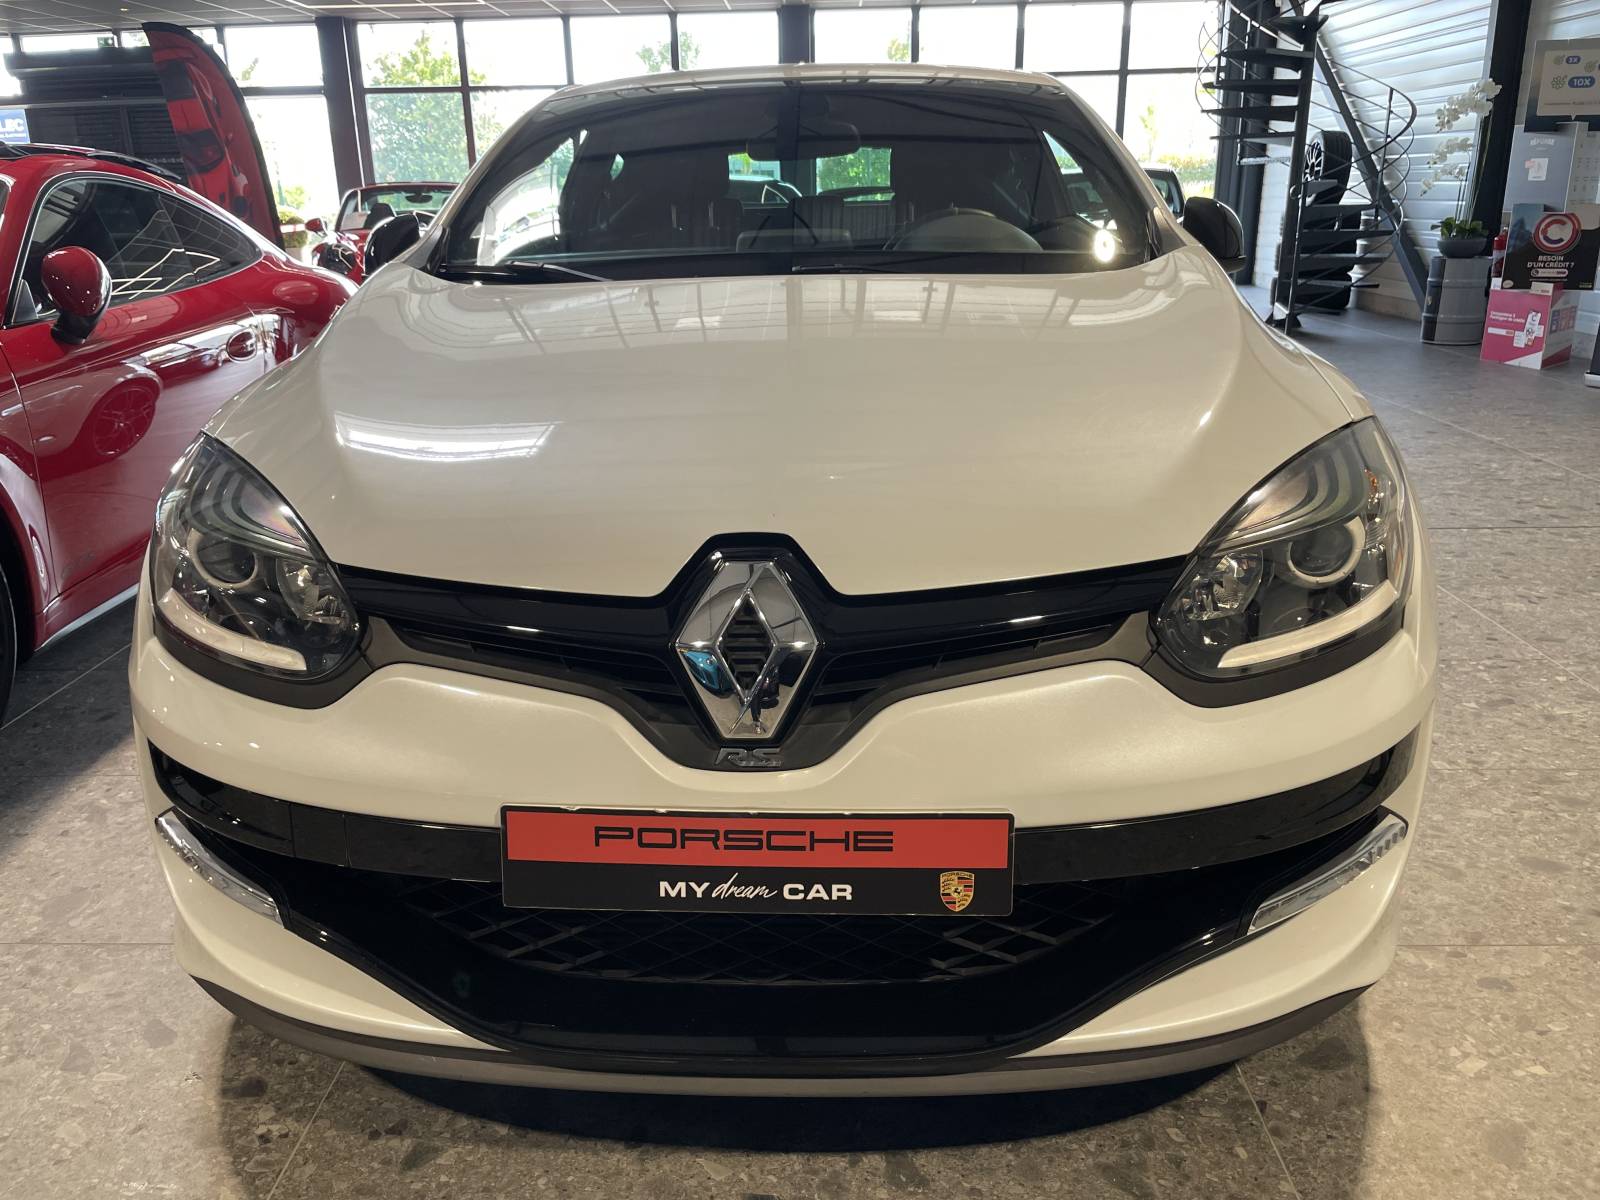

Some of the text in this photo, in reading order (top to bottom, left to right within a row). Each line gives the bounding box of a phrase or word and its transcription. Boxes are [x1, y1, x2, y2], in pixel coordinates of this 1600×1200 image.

[1573, 78, 1591, 87] 10X
[594, 826, 894, 852] PORSCHE
[659, 872, 853, 901] MY dream CAR
